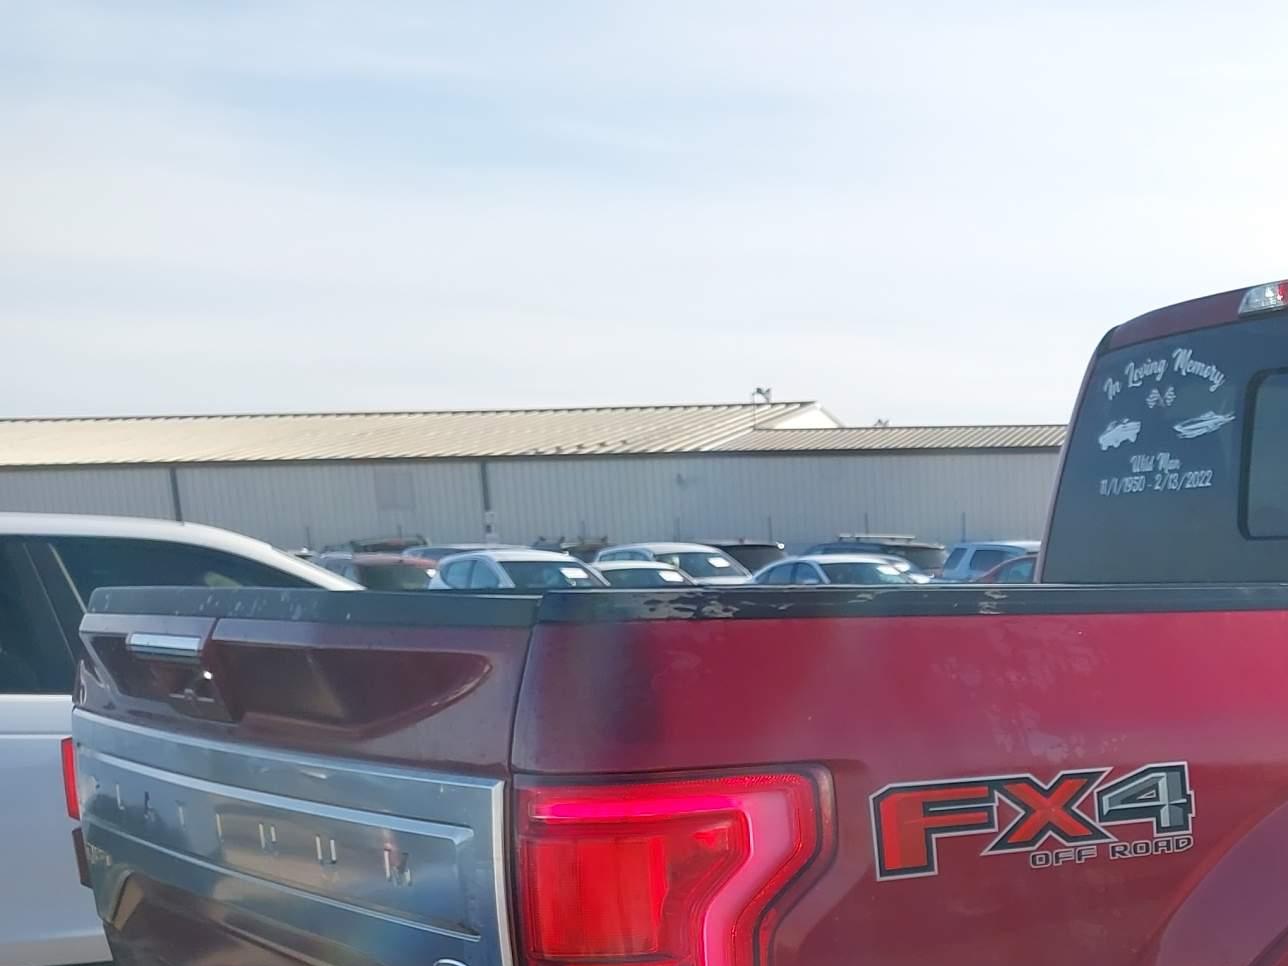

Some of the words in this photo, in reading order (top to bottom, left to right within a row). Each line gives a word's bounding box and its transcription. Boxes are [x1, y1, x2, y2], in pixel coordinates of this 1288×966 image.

[1103, 377, 1121, 400] In
[1124, 358, 1168, 388] Loving
[1172, 348, 1226, 392] Memory
[1154, 470, 1213, 491] 2/13/2022
[869, 761, 1196, 881] FX4
[1030, 845, 1097, 868] OFF
[1109, 836, 1194, 860] ROAD
